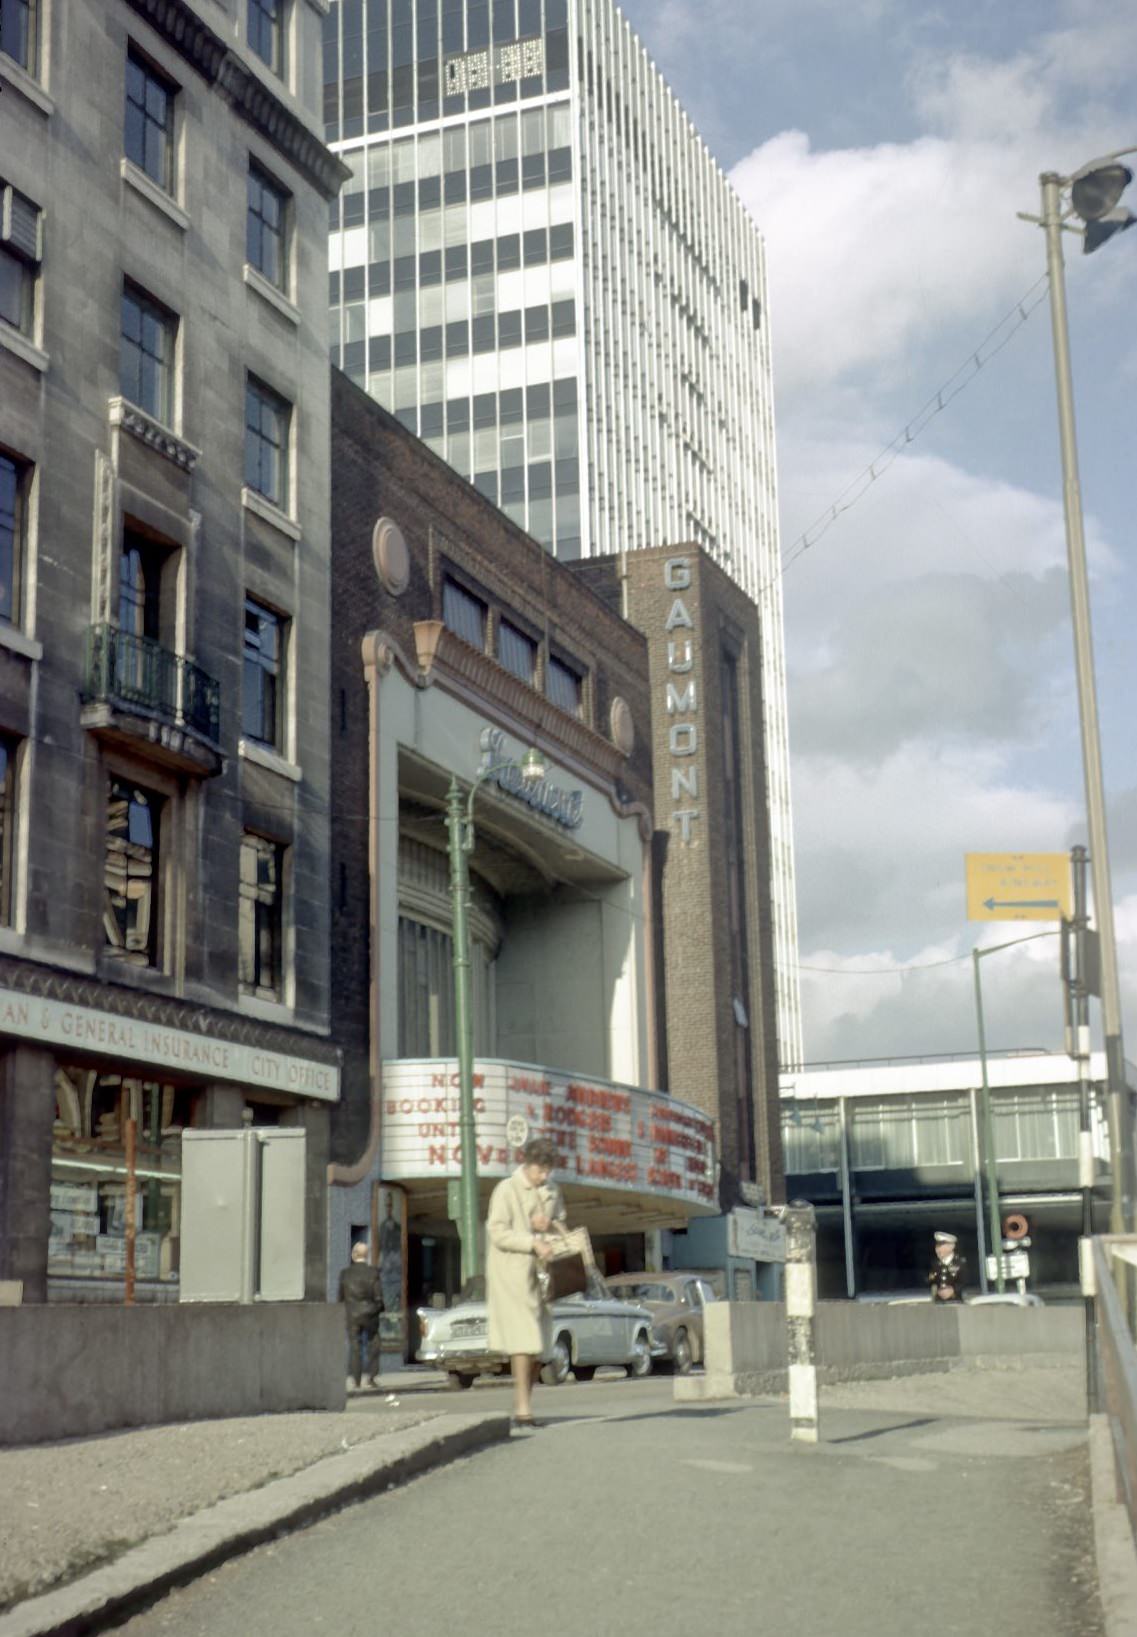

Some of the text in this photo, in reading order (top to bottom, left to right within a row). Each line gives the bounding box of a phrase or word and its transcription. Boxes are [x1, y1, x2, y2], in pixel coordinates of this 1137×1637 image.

[664, 557, 700, 841] GAUMONT
[61, 1011, 136, 1049] GENERAL
[143, 1030, 229, 1068] INSURANCE
[251, 1055, 280, 1081] CITY
[289, 1064, 330, 1091] OFFICE
[386, 1098, 486, 1115] BOOKIG
